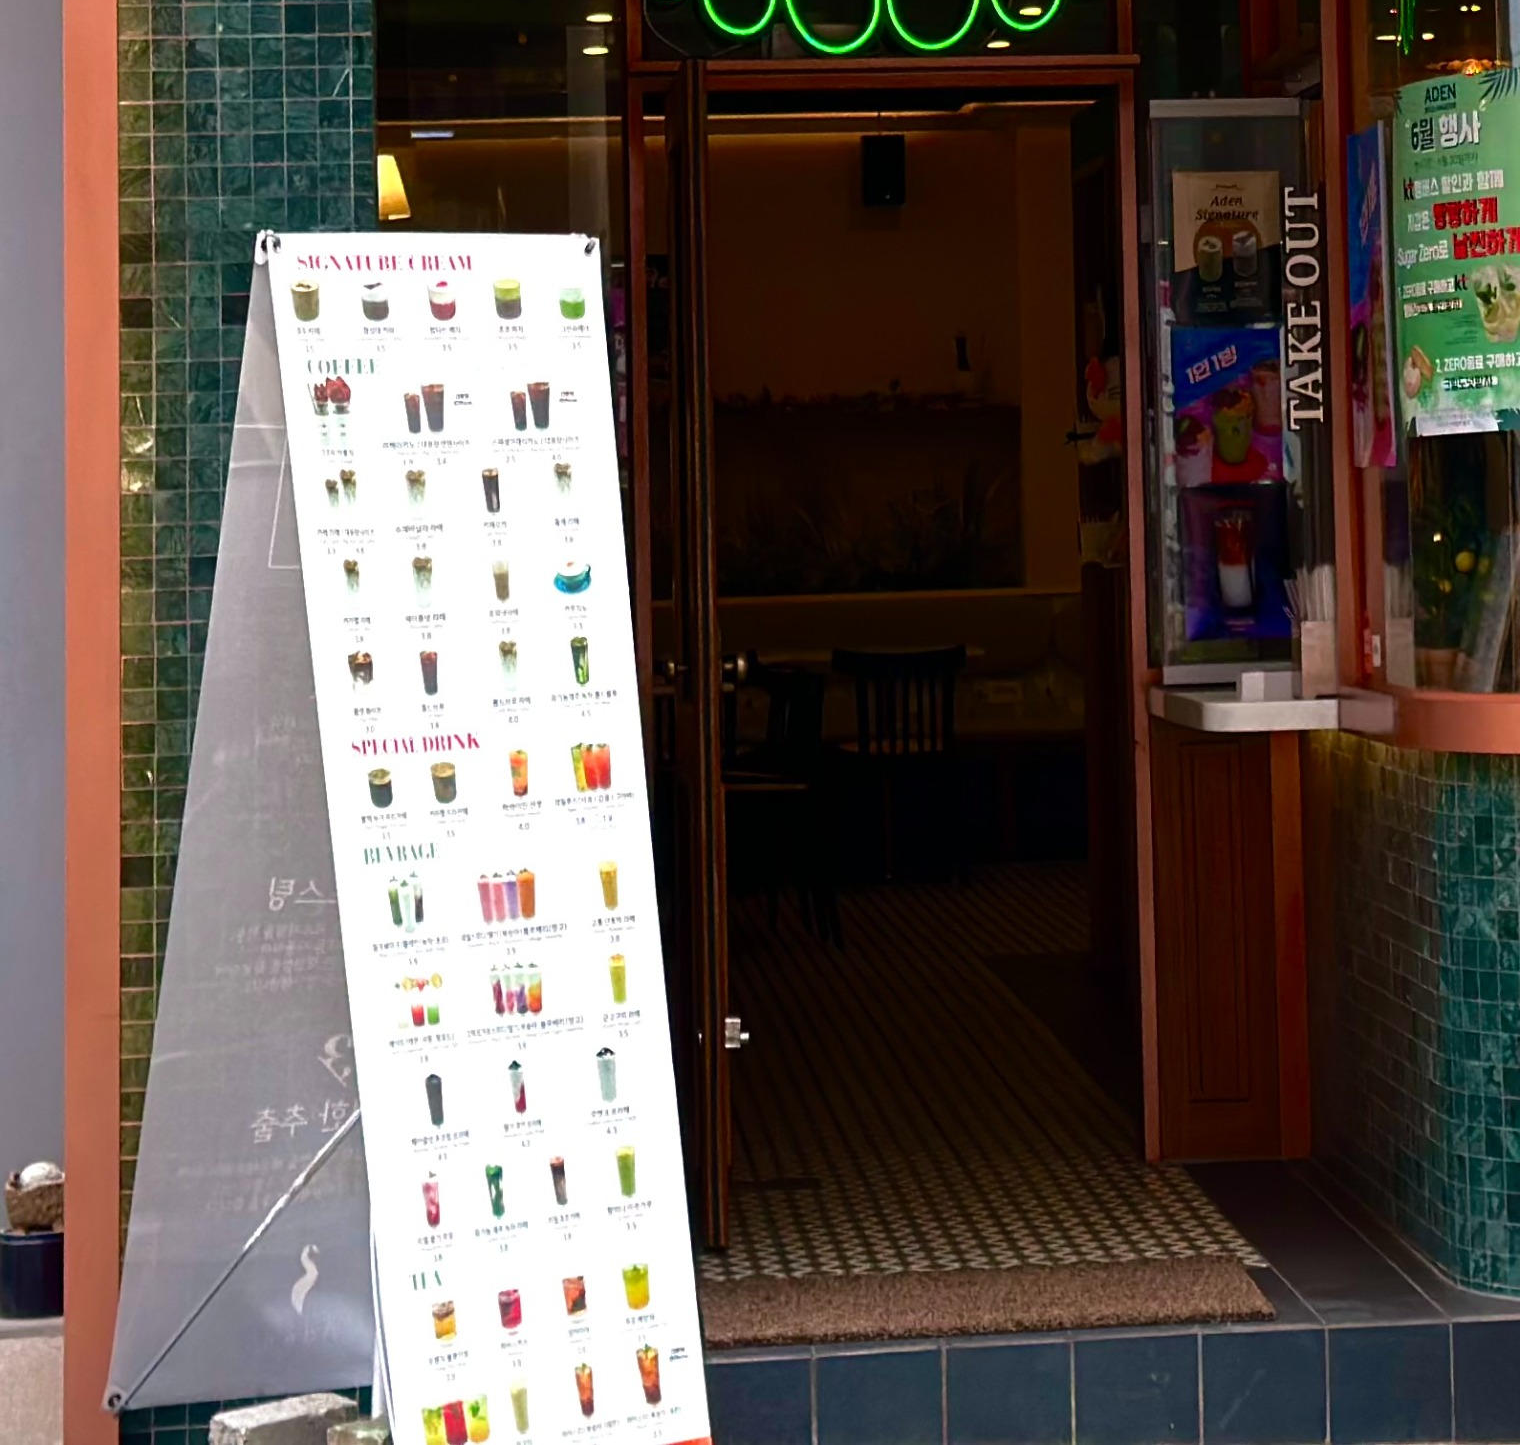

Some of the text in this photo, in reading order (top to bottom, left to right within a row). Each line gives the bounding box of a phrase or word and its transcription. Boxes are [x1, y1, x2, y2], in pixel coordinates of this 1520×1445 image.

[1424, 83, 1456, 104] ADEN
[1411, 110, 1481, 152] 6월 행사
[1210, 195, 1243, 207] Aden
[1195, 209, 1258, 222] Signature
[297, 255, 472, 271] SIGNATURE CREAM
[1283, 186, 1325, 432] TAKE OUT
[307, 358, 380, 375] COFFEE
[352, 733, 480, 755] SPECIAL DRINK
